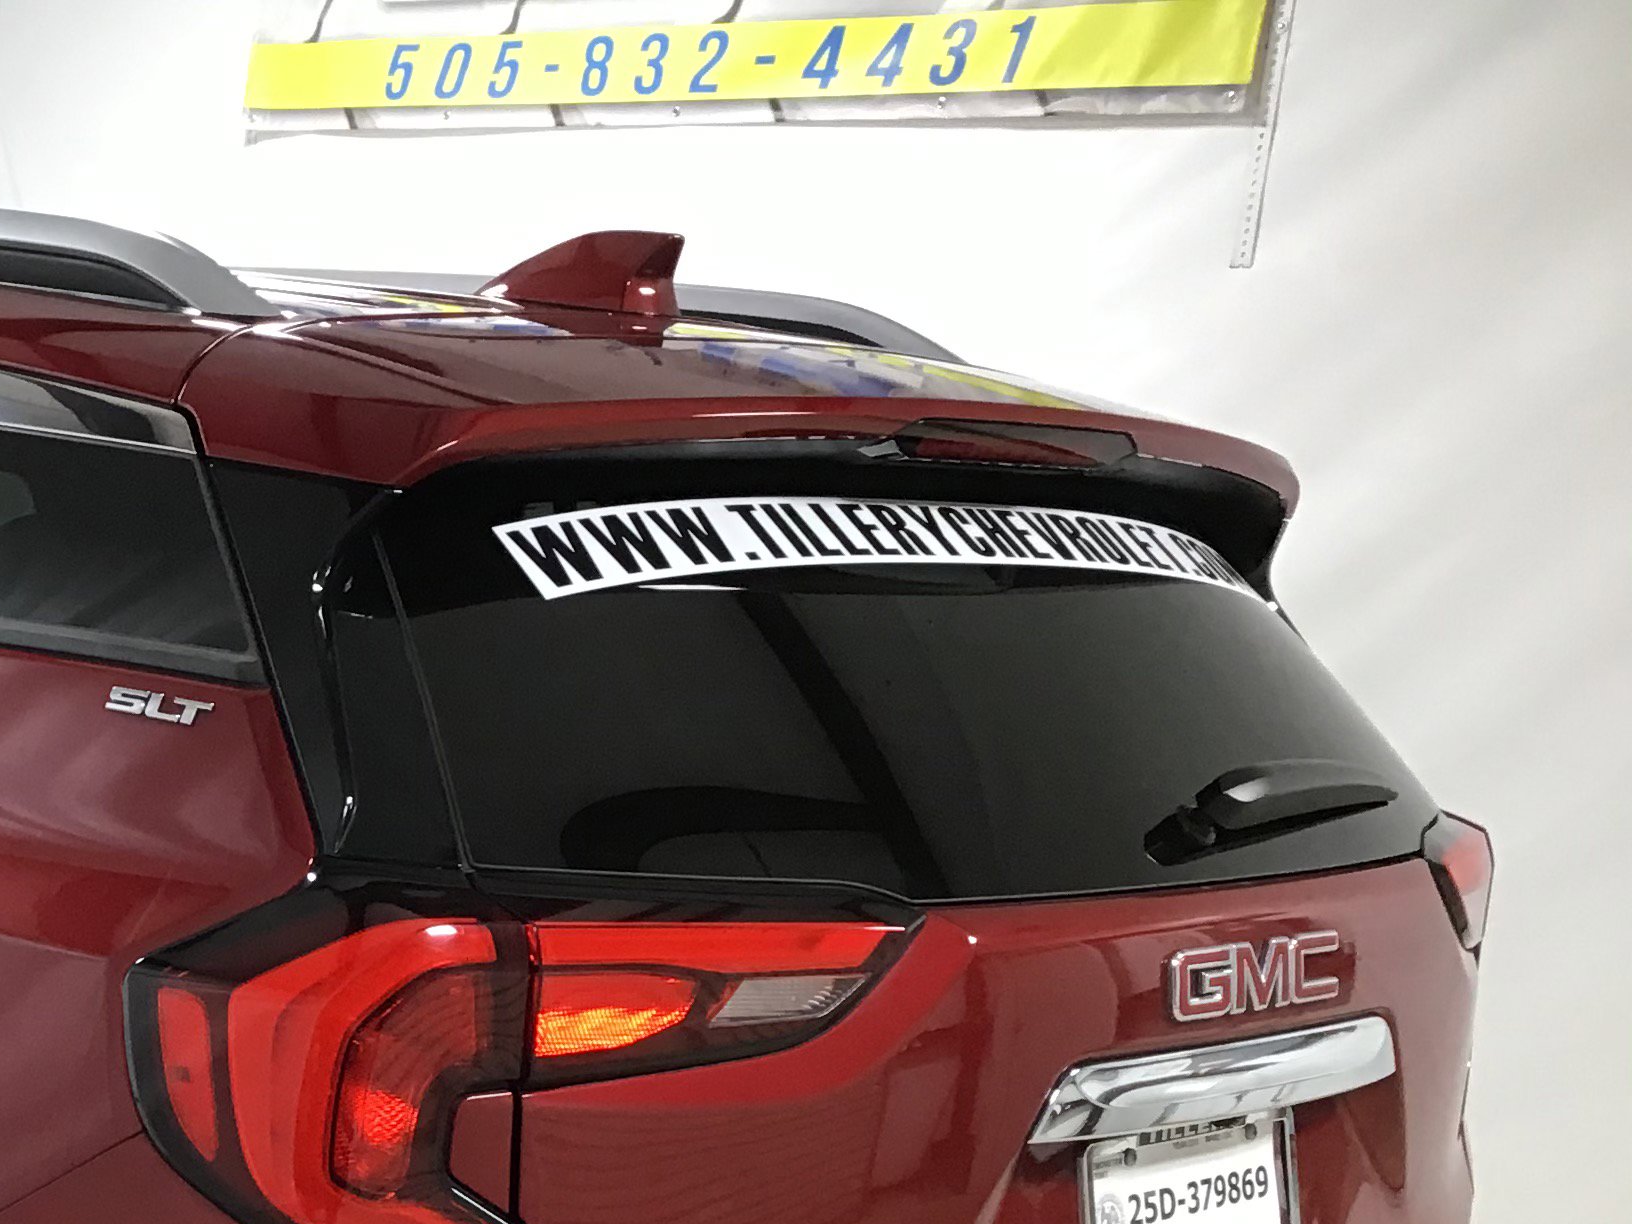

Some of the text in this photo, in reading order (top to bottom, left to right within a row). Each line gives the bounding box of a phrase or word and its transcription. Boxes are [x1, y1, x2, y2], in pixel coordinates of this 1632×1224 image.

[384, 16, 1036, 100] 505-832-4431
[105, 685, 215, 726] SLT
[1171, 929, 1339, 1022] GMC
